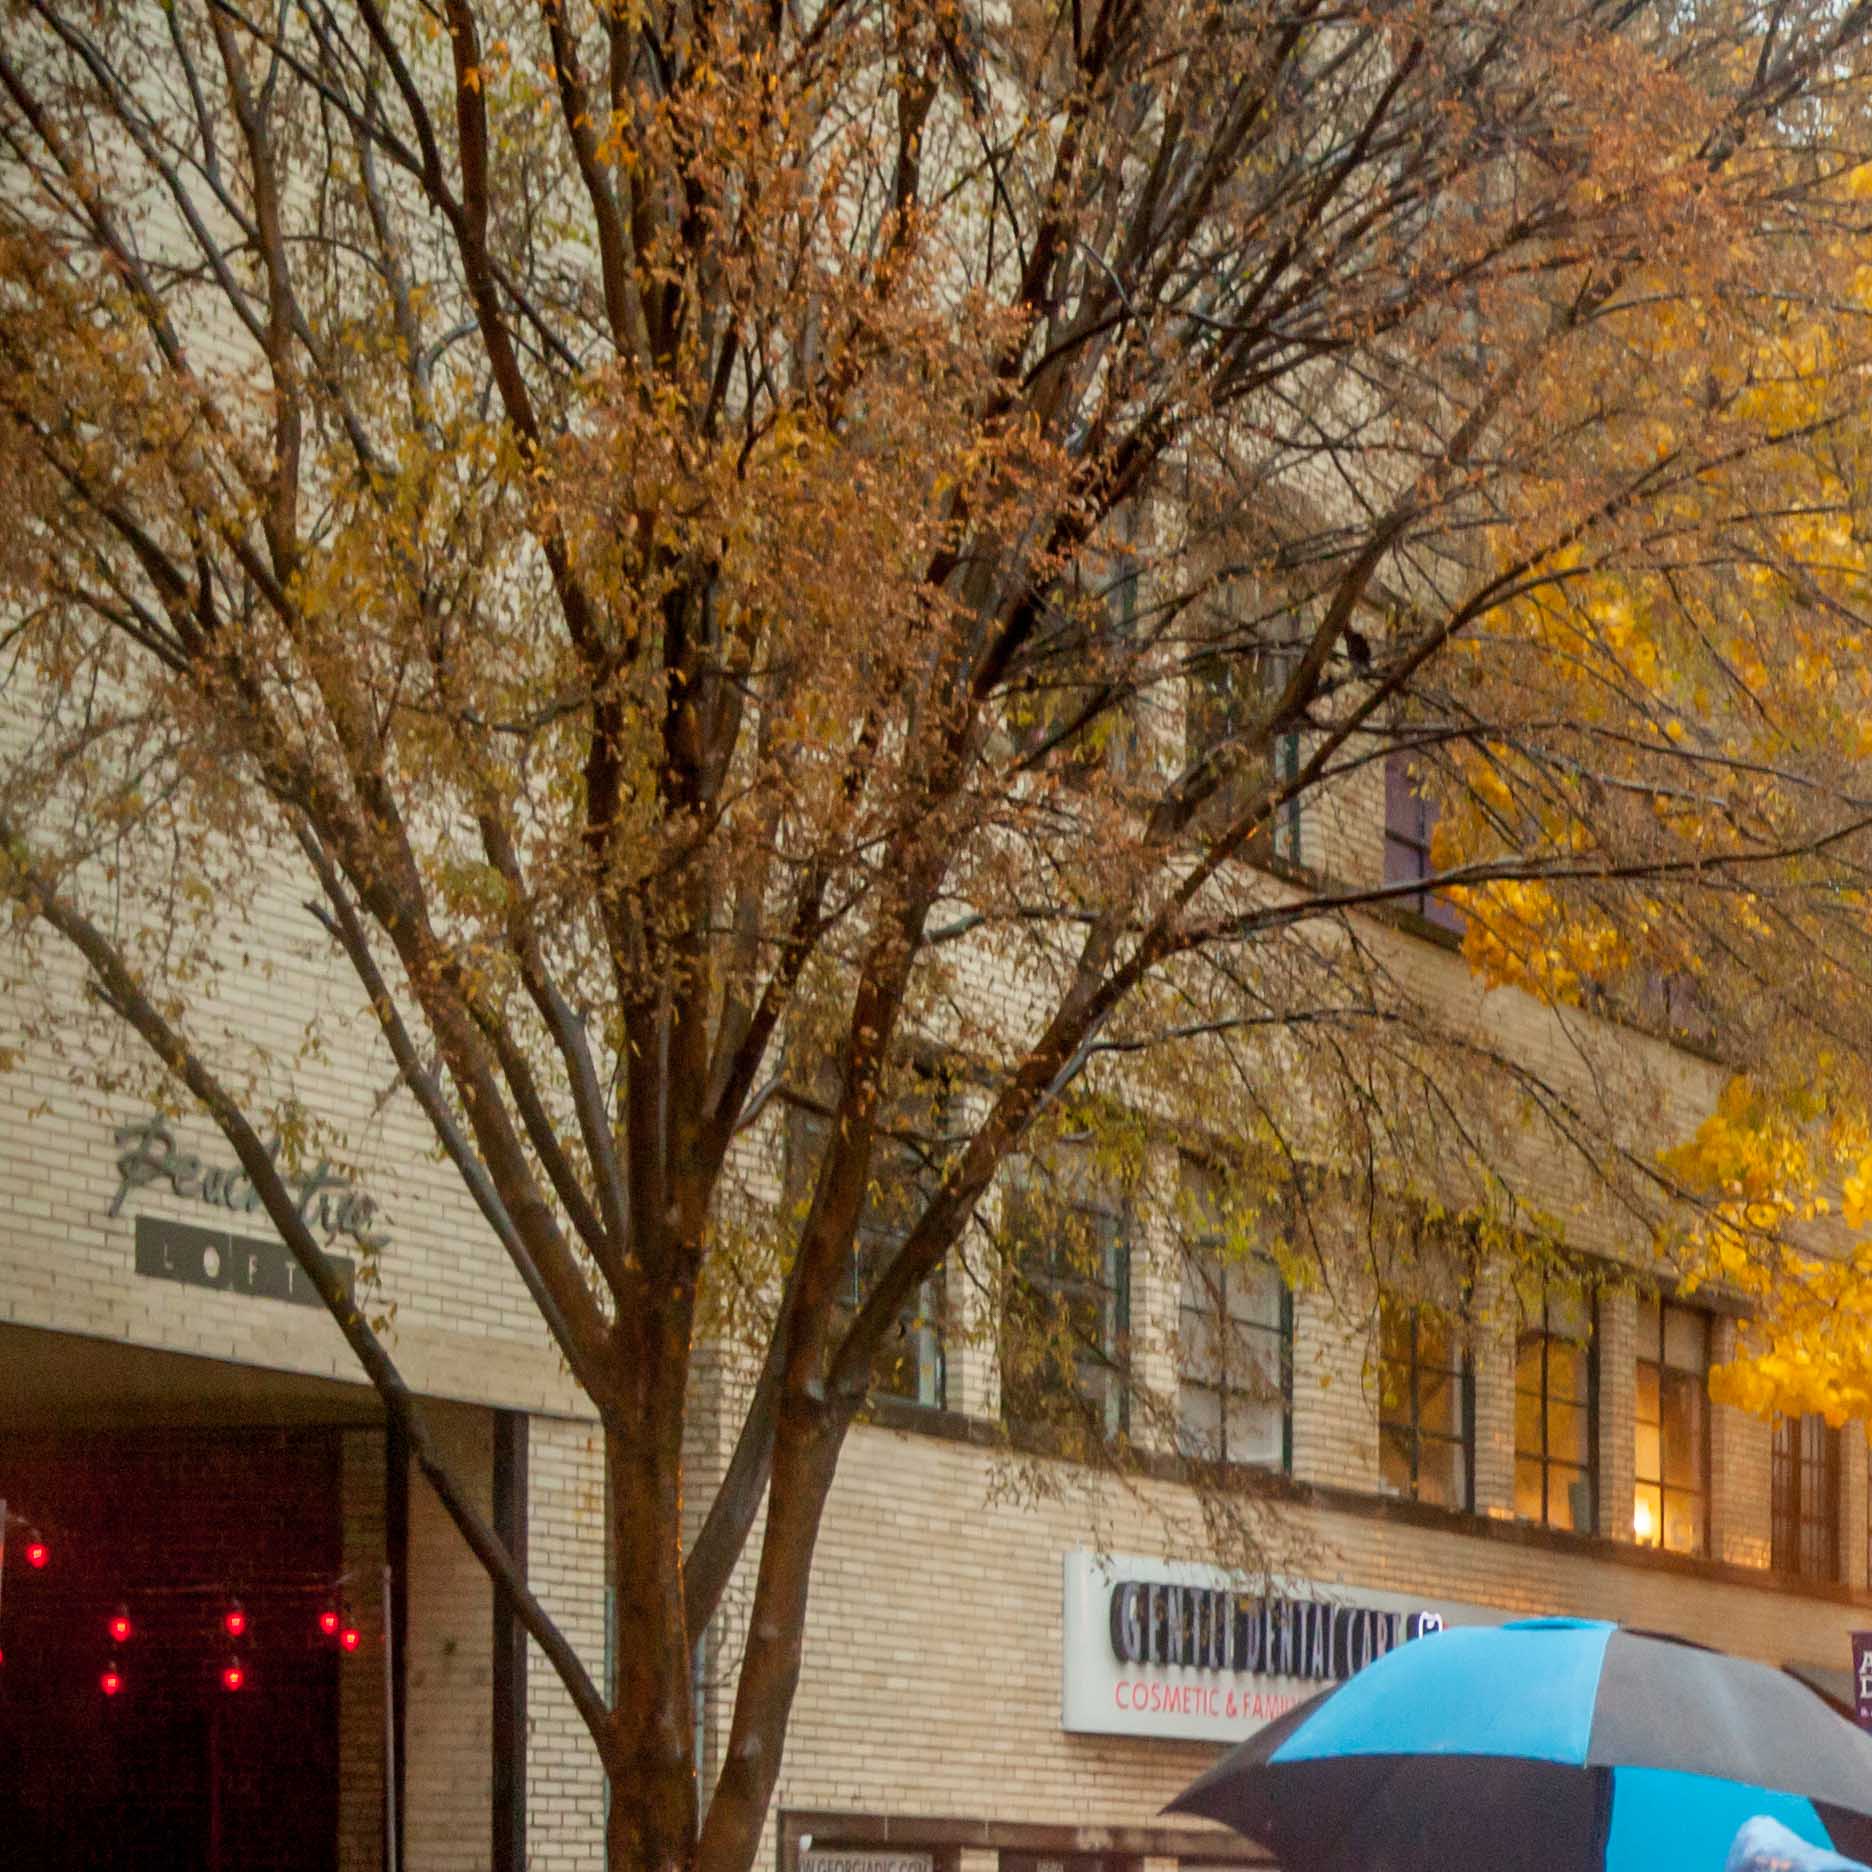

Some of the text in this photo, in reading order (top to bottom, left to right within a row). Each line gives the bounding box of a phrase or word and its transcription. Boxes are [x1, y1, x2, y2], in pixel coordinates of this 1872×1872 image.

[109, 1114, 391, 1250] Peactree
[1115, 1680, 1219, 1718] COSMETIC
[1225, 1694, 1237, 1718] &
